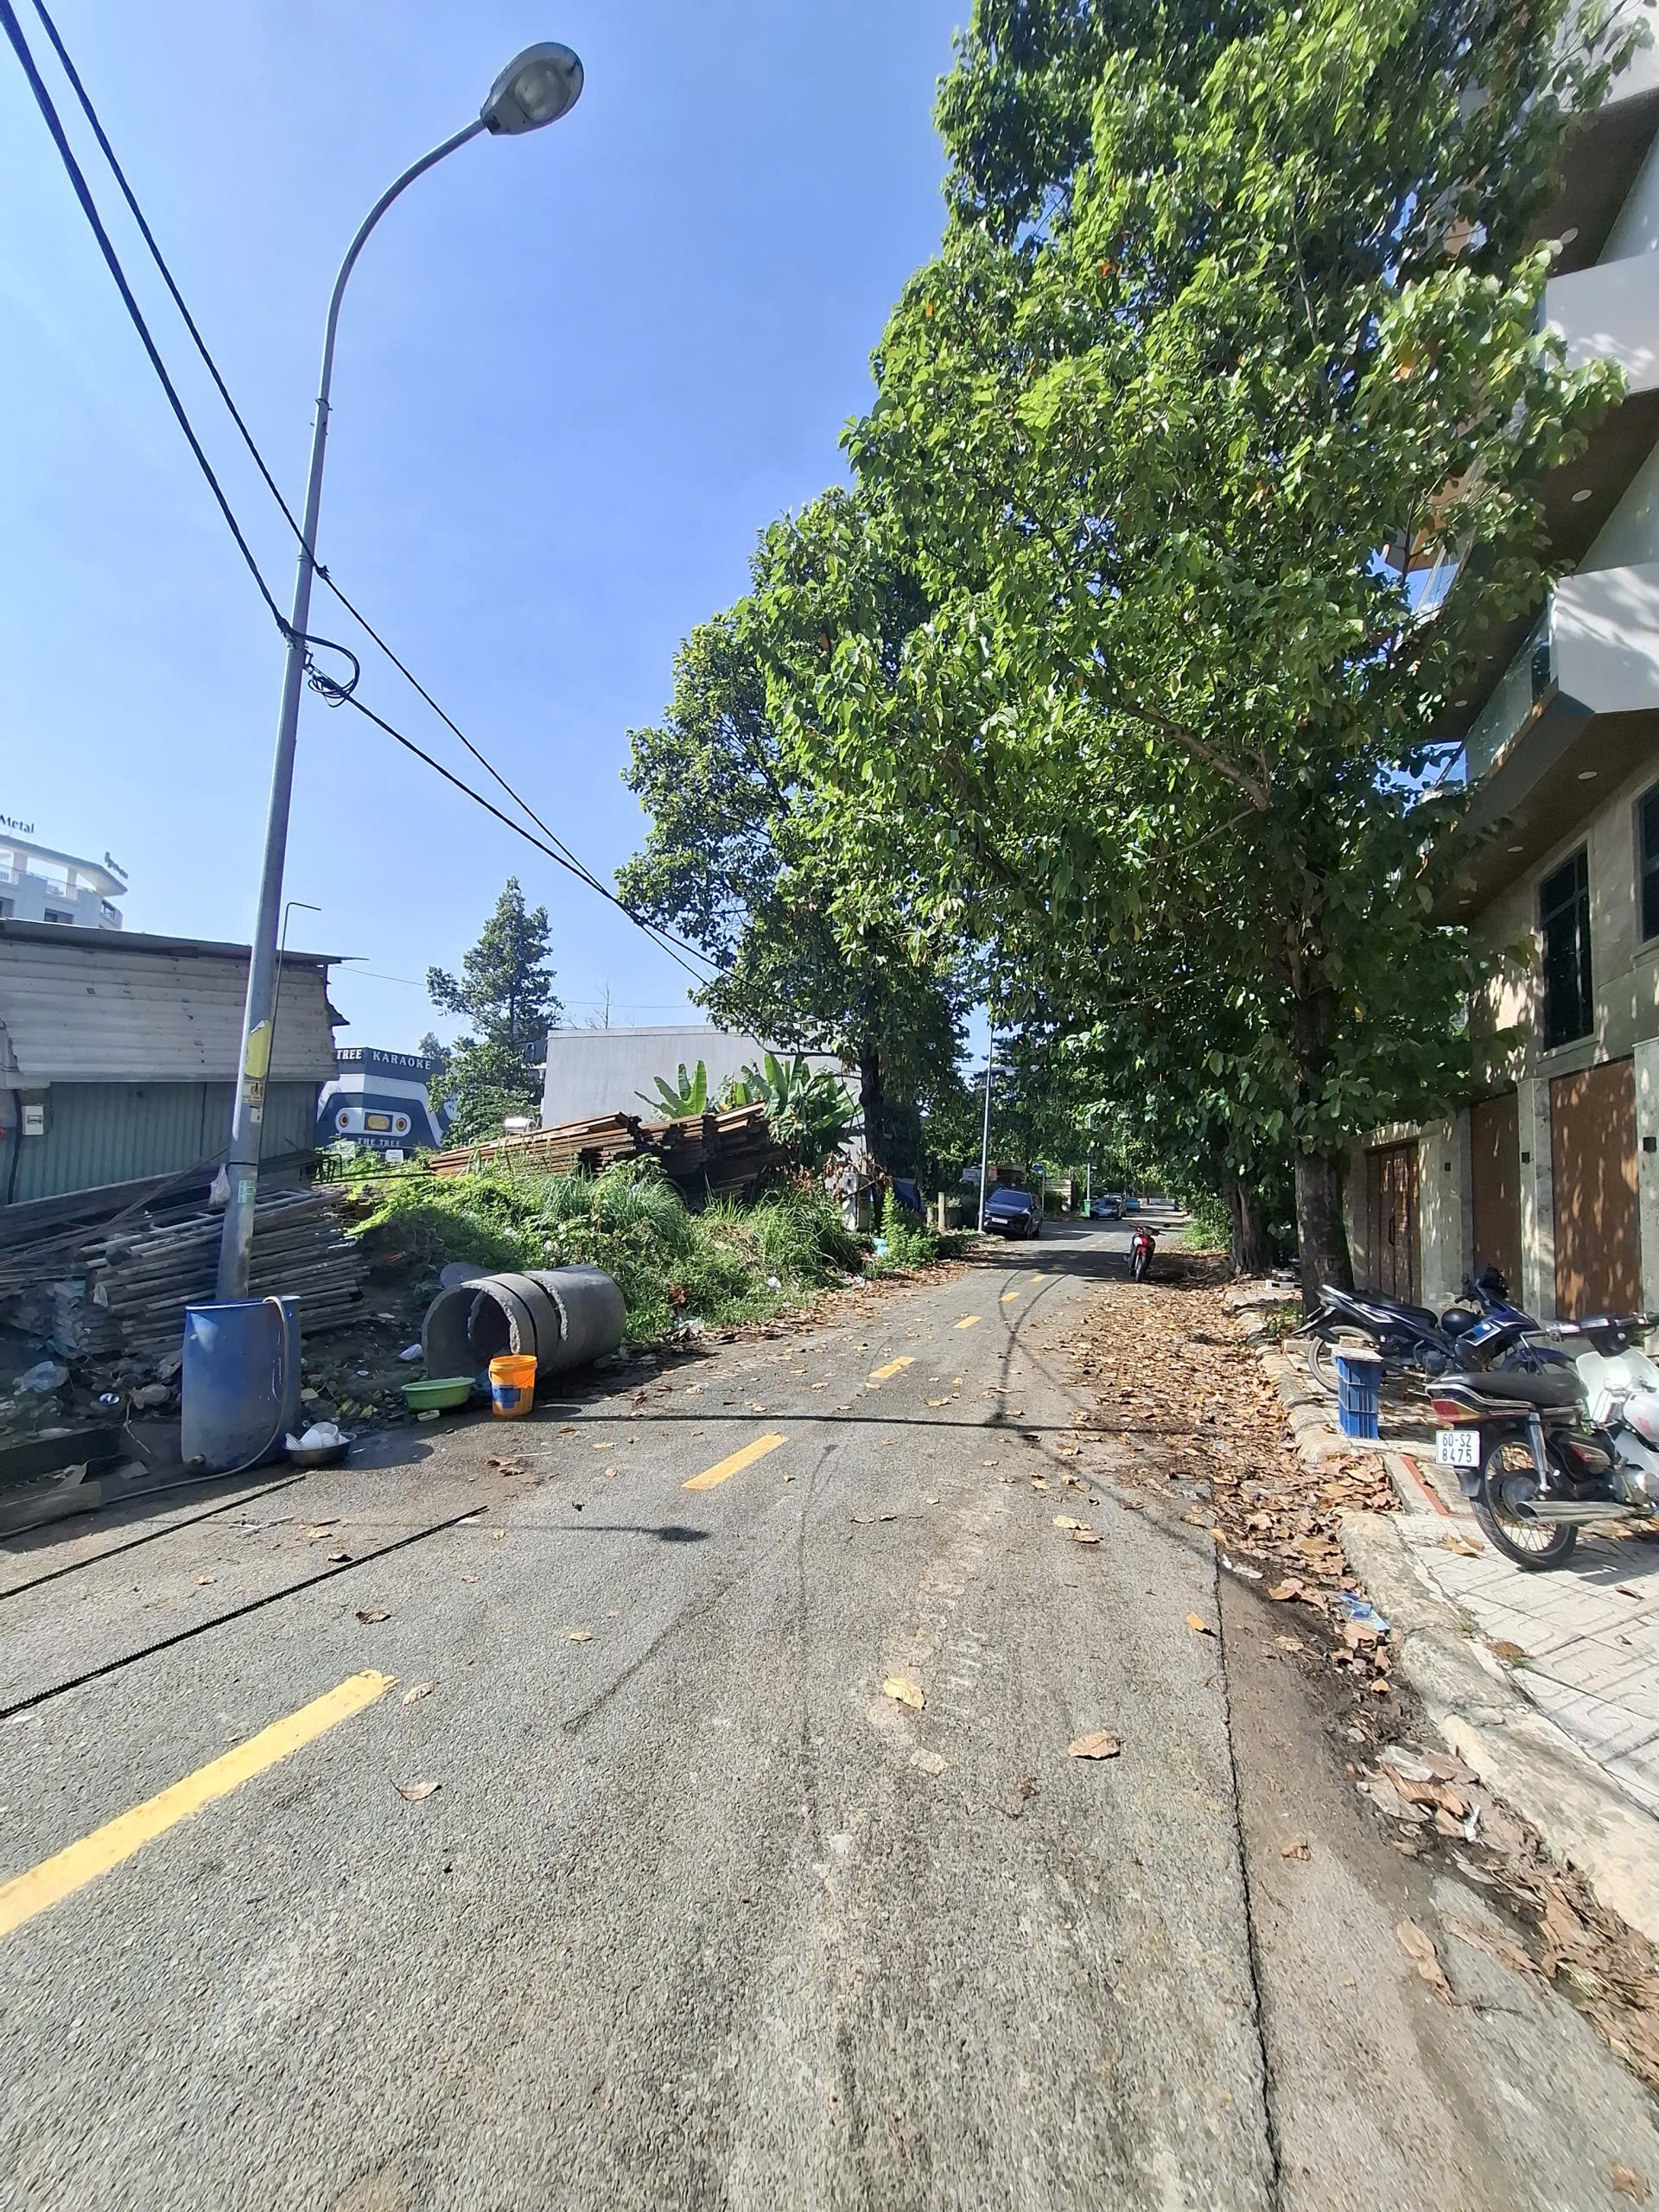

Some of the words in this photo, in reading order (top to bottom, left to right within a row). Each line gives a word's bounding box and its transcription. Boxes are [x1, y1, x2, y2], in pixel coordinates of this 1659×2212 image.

[0, 814, 35, 834] Metal
[336, 1049, 362, 1060] TREE
[372, 1052, 431, 1070] KARAOKE
[357, 1137, 376, 1146] THE
[379, 1139, 402, 1147] TREE
[1442, 1433, 1471, 1447] 60-S2
[1442, 1448, 1472, 1463] 8475
